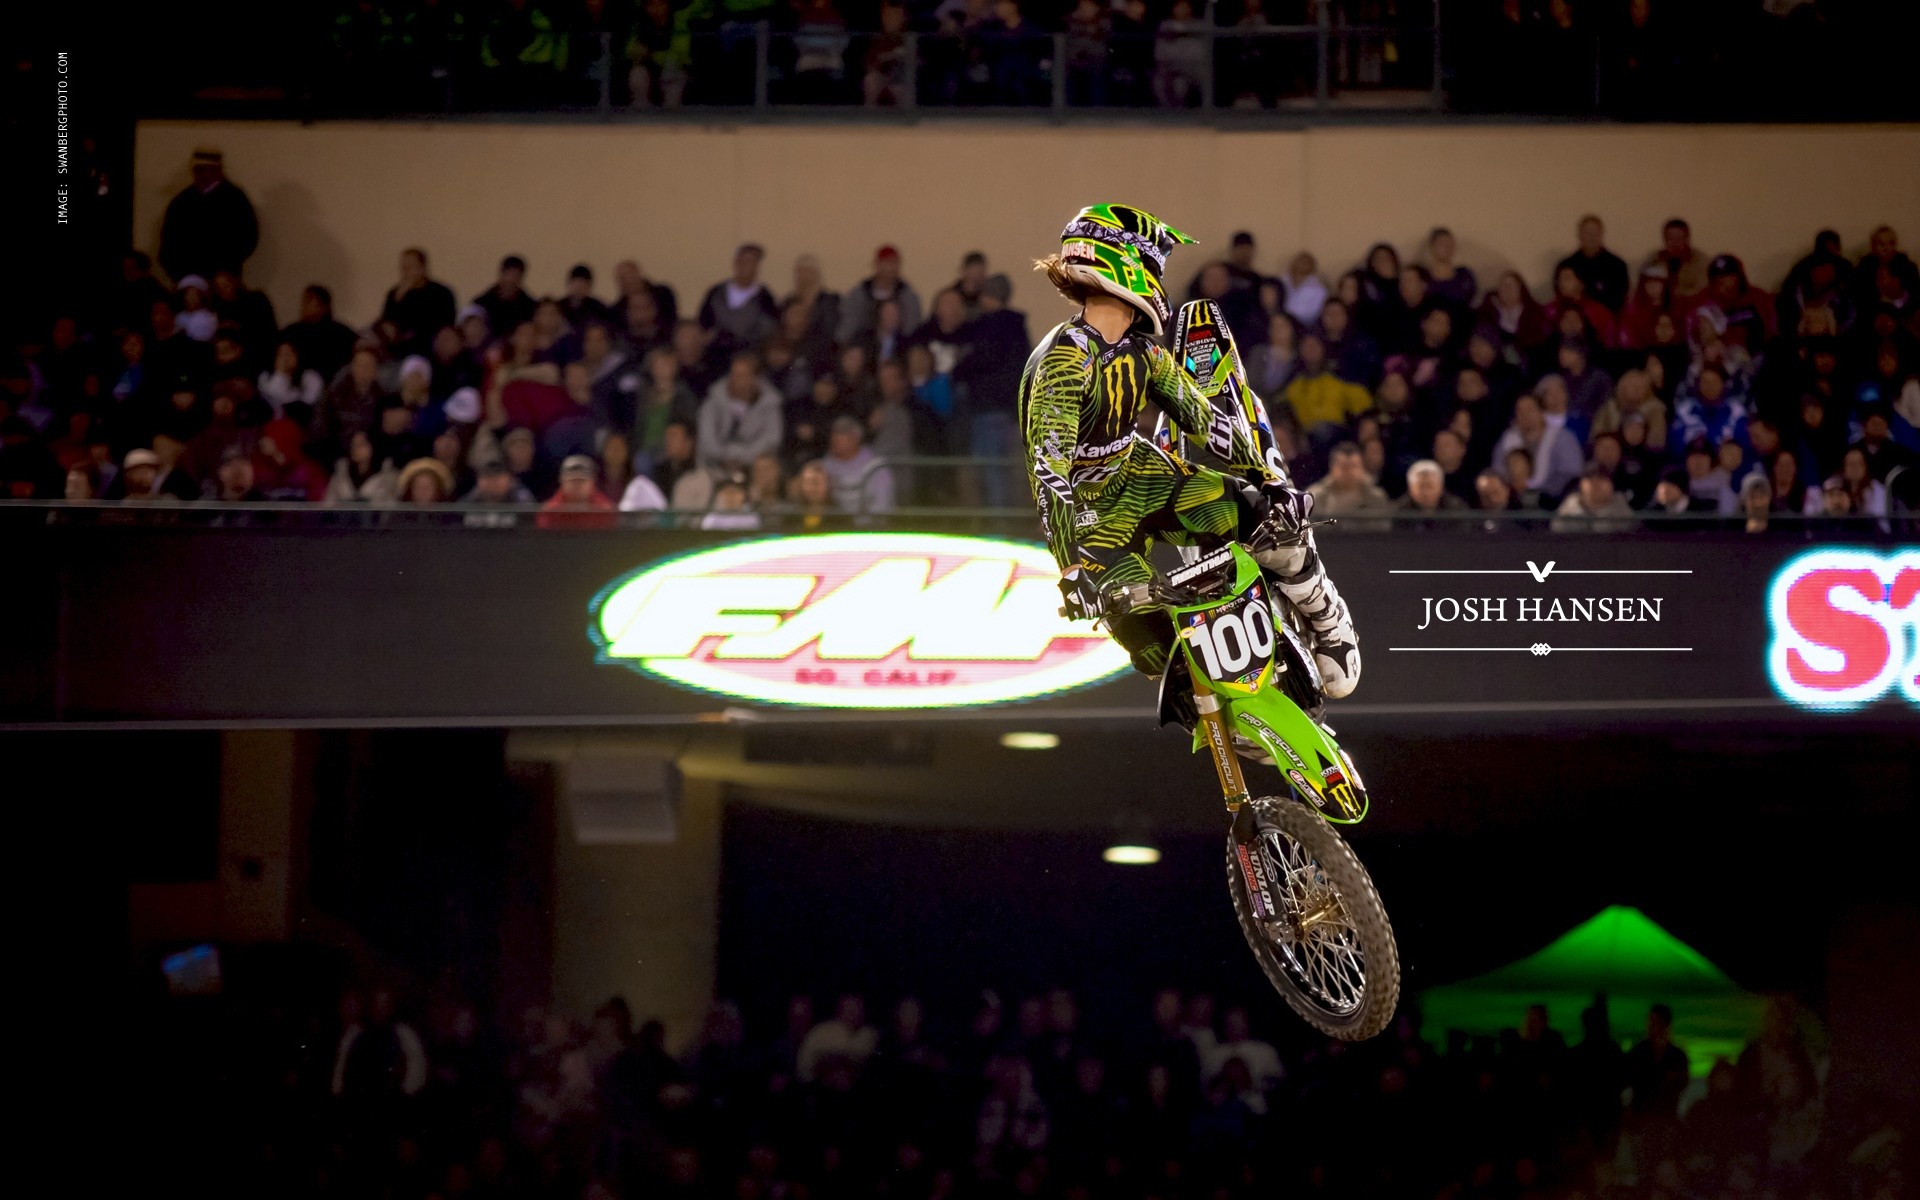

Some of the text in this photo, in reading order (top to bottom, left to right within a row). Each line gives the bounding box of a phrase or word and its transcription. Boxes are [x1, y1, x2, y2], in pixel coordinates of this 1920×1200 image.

[1076, 515, 1098, 526] ANS
[1189, 599, 1274, 680] 100
[1209, 720, 1223, 745] PRO
[1217, 745, 1238, 792] CIRCUIT
[1239, 712, 1263, 727] PRO
[1260, 727, 1308, 771] CIRCUIT
[1250, 849, 1276, 916] UNLOP
